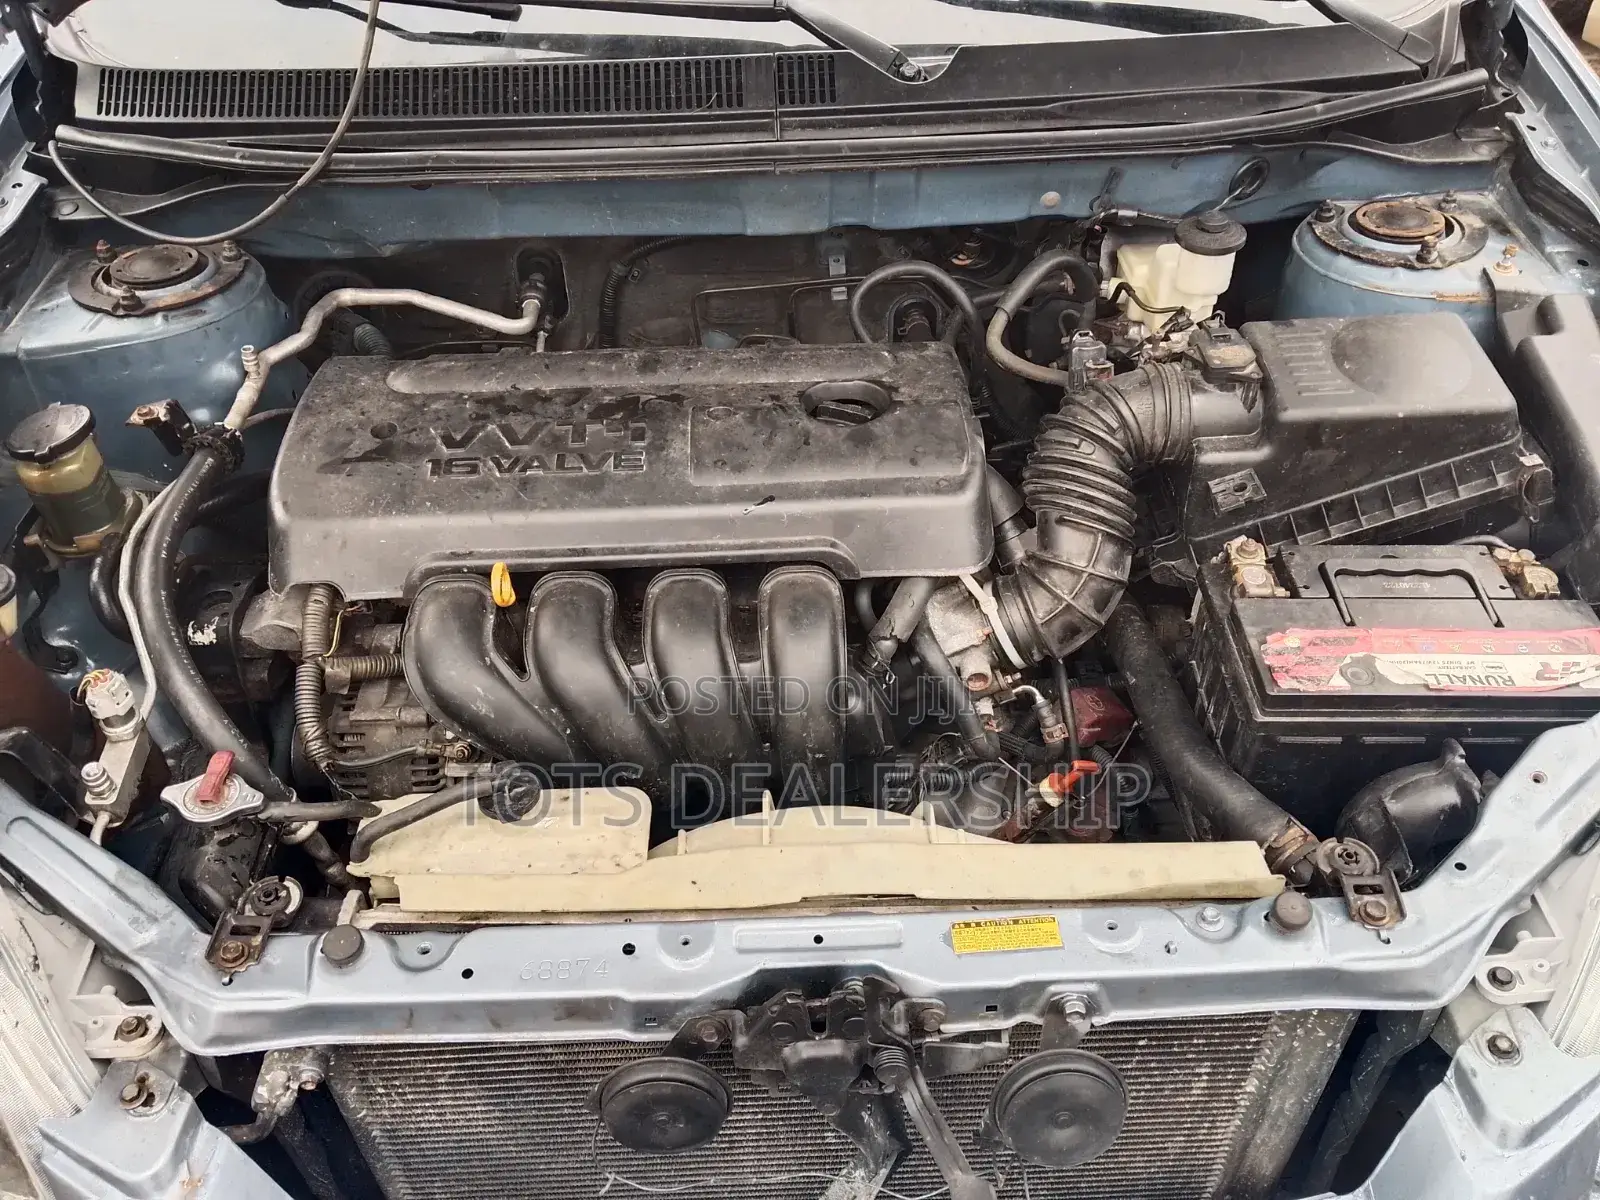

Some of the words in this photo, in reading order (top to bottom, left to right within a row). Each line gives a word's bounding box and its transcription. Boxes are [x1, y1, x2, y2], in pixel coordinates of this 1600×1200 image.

[425, 456, 483, 479] 16
[489, 451, 646, 478] VALVE
[1425, 673, 1515, 687] RUNALL
[980, 919, 1014, 927] CAUTION
[1018, 917, 1055, 925] ATTENTION
[520, 958, 609, 980] 68874
